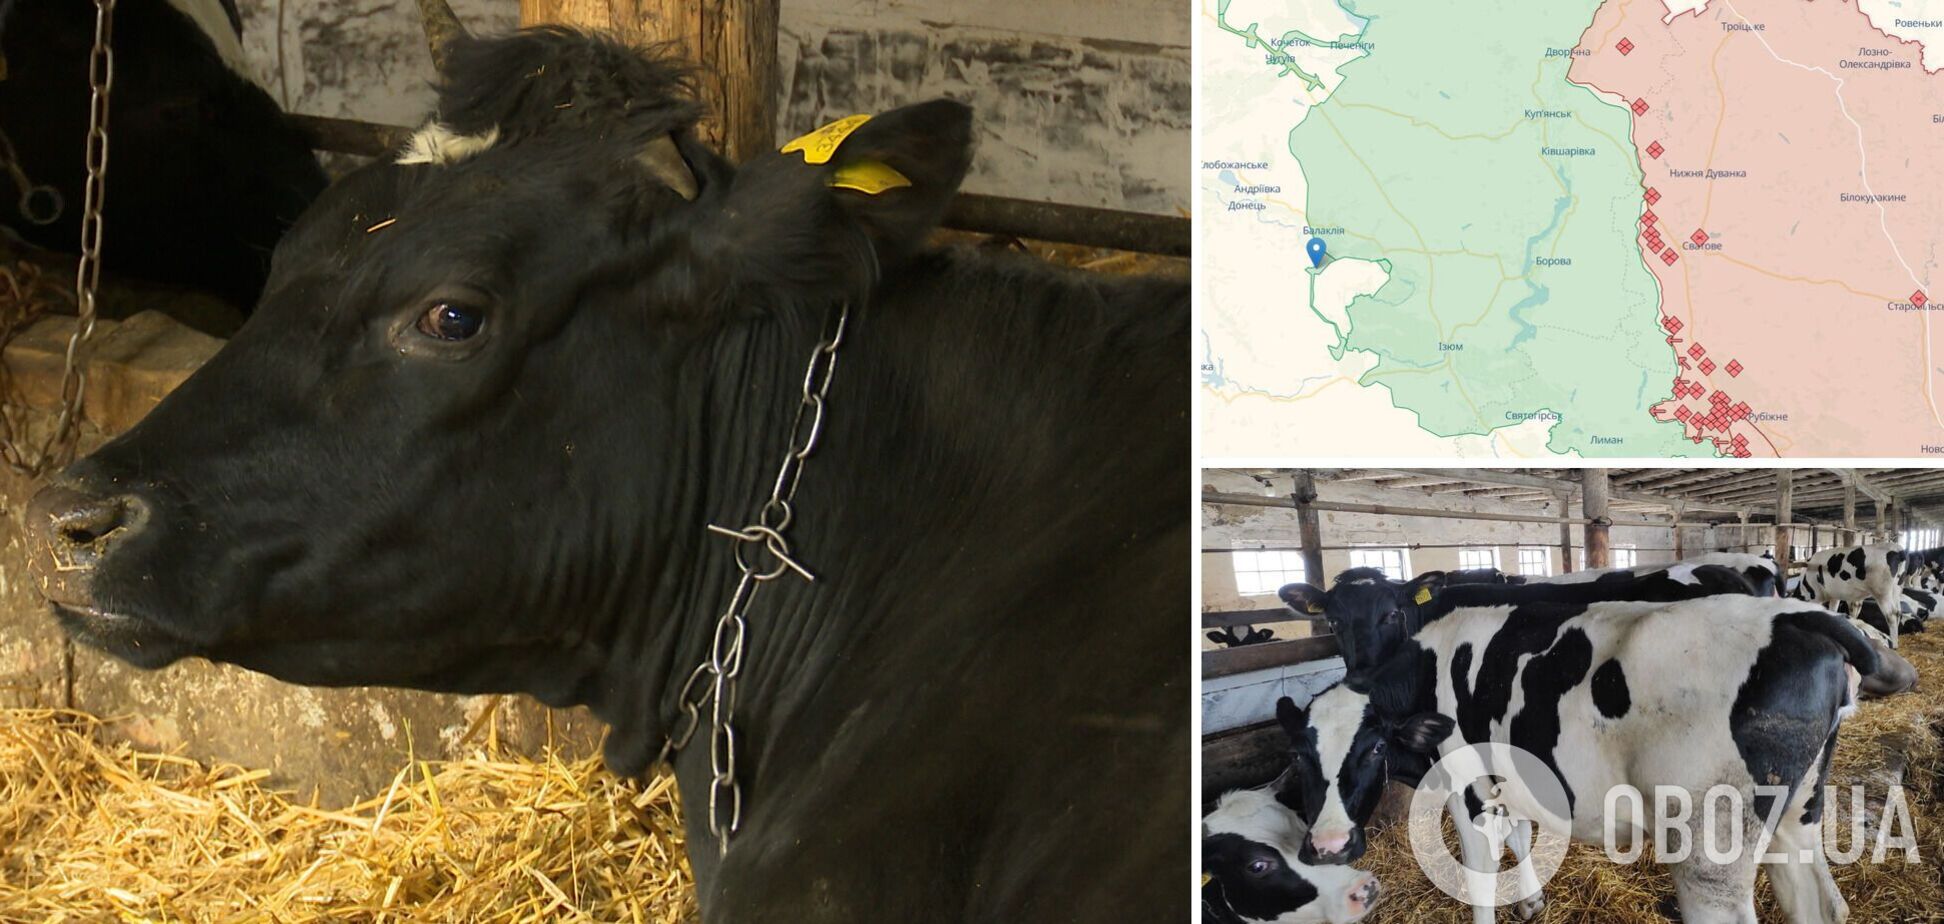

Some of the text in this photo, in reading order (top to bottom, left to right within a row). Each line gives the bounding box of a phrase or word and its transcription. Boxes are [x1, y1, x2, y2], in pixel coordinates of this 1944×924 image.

[1895, 18, 1942, 29] Ровеньки
[1271, 38, 1311, 47] Кочеток
[1545, 46, 1591, 58] Дворічна
[1858, 47, 1892, 57] Лозно-
[1839, 60, 1911, 70] Олександрівка
[1541, 146, 1596, 157] Ківшарівка
[1201, 160, 1269, 169] лобожанське
[1669, 168, 1747, 179] Нижня Дуванка
[1234, 184, 1281, 195] Андріївка
[1840, 192, 1907, 204] Білокуракине
[1228, 201, 1266, 212] Донець
[1302, 226, 1345, 236] Балаклія
[1535, 256, 1572, 266] Борова
[1438, 341, 1463, 352] Ізюм
[1749, 411, 1788, 423] Рубіжне
[1590, 436, 1623, 445] Лиман
